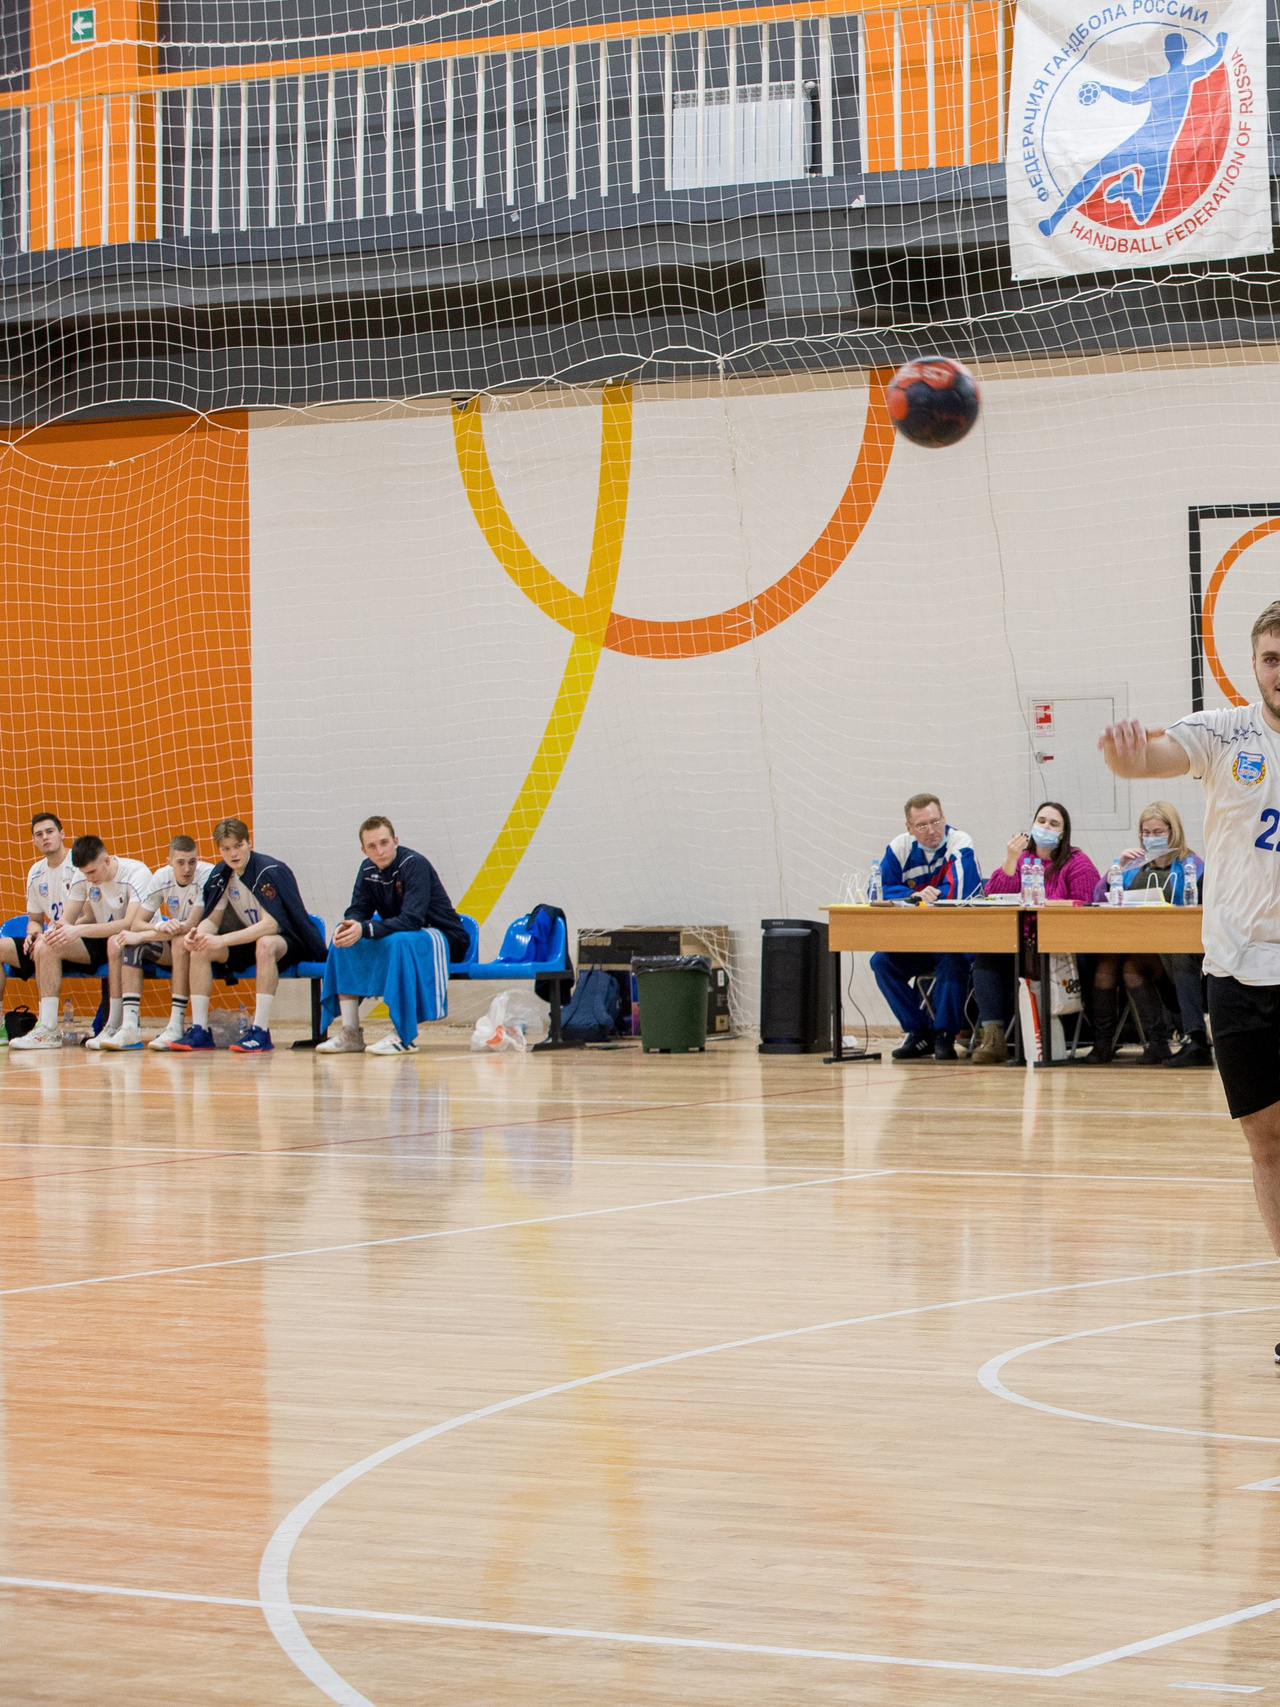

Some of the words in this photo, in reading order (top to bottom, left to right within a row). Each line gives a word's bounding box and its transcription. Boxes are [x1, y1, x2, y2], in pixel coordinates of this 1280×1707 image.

[1021, 77, 1050, 202] ФЕДЕРАЦИЯ
[1043, 5, 1127, 77] ГАНДБОЛА
[1132, 0, 1209, 25] РОССИИ
[1230, 48, 1254, 115] RUSSIA
[1236, 121, 1252, 147] OF
[1165, 150, 1246, 246] FEDERATION
[1070, 220, 1162, 254] HANDBALL
